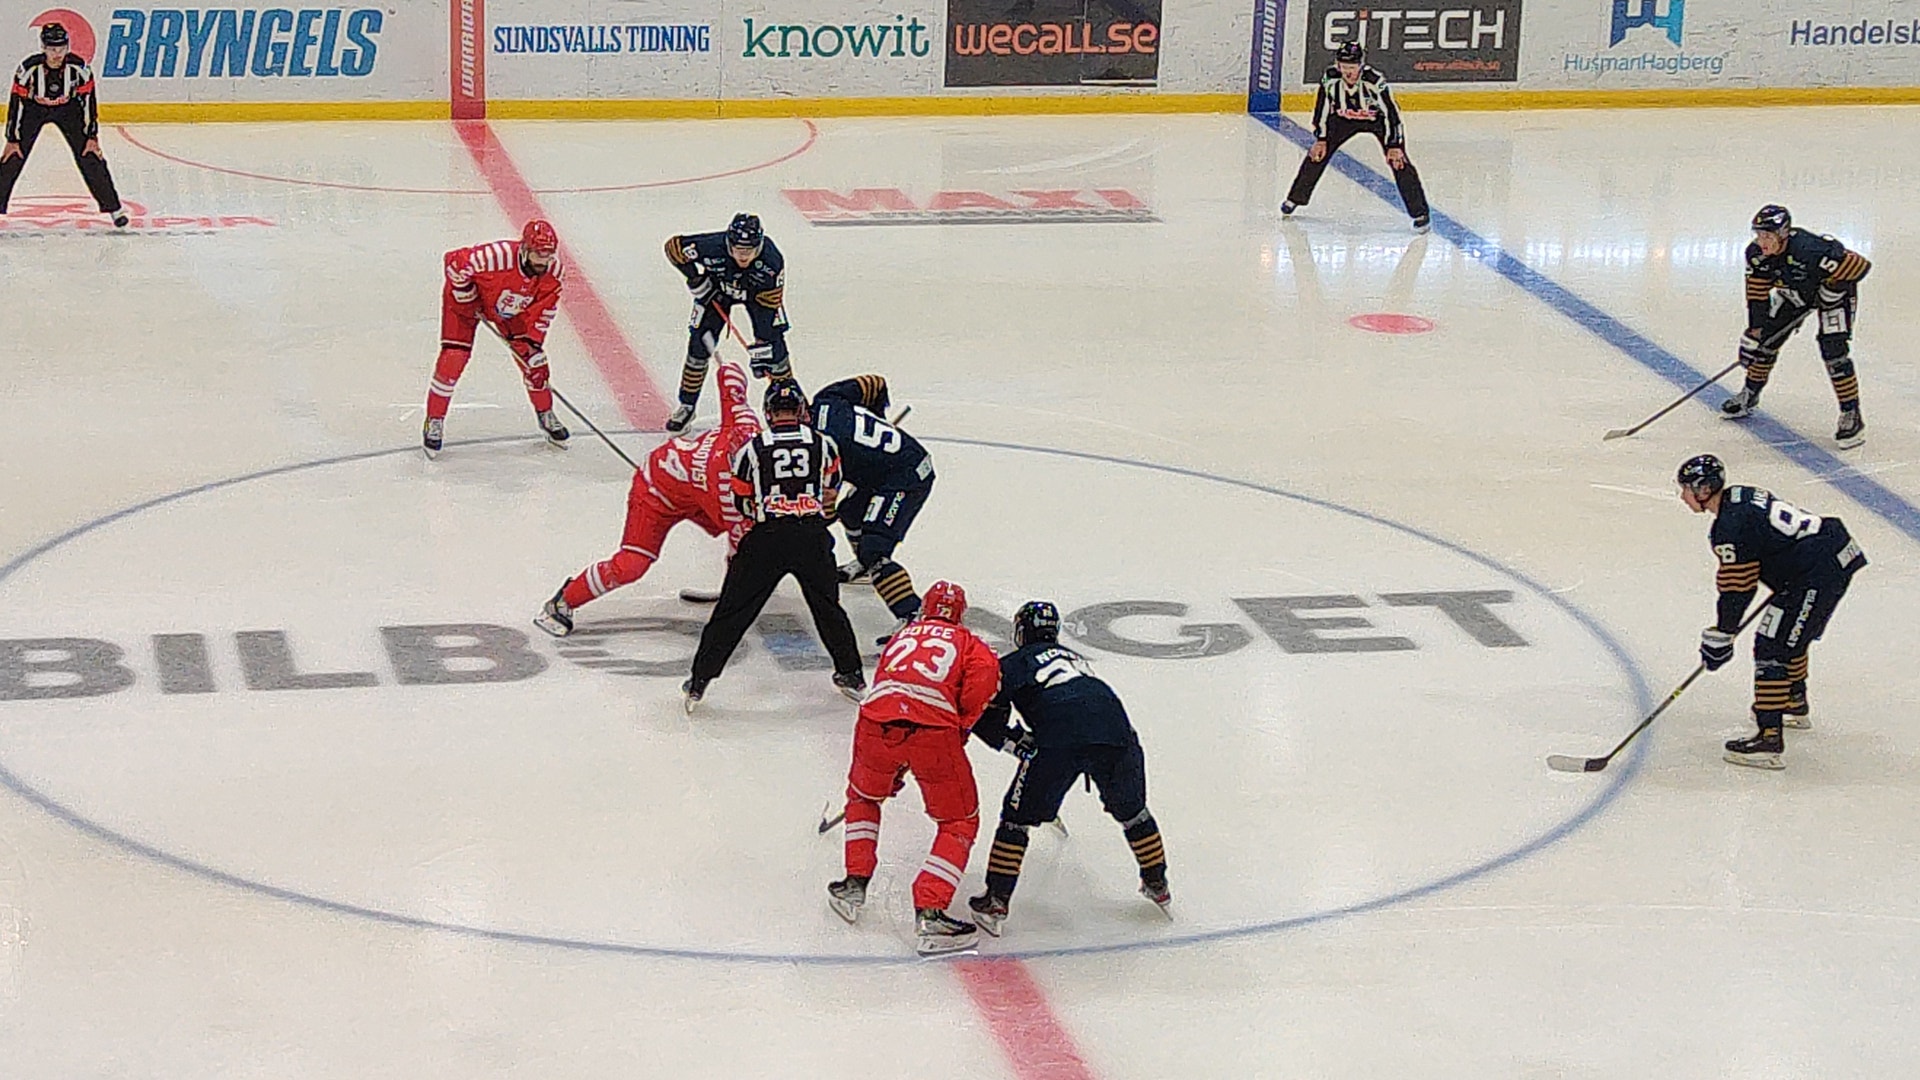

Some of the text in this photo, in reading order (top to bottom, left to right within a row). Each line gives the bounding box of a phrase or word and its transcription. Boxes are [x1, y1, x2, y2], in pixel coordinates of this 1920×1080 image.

[102, 9, 383, 78] BRYNGELS
[494, 25, 710, 54] SUNDSVALLS TIDNING
[743, 15, 930, 57] knowit
[780, 189, 1148, 211] MAXI
[773, 449, 810, 478] 23
[885, 637, 958, 683] 23
